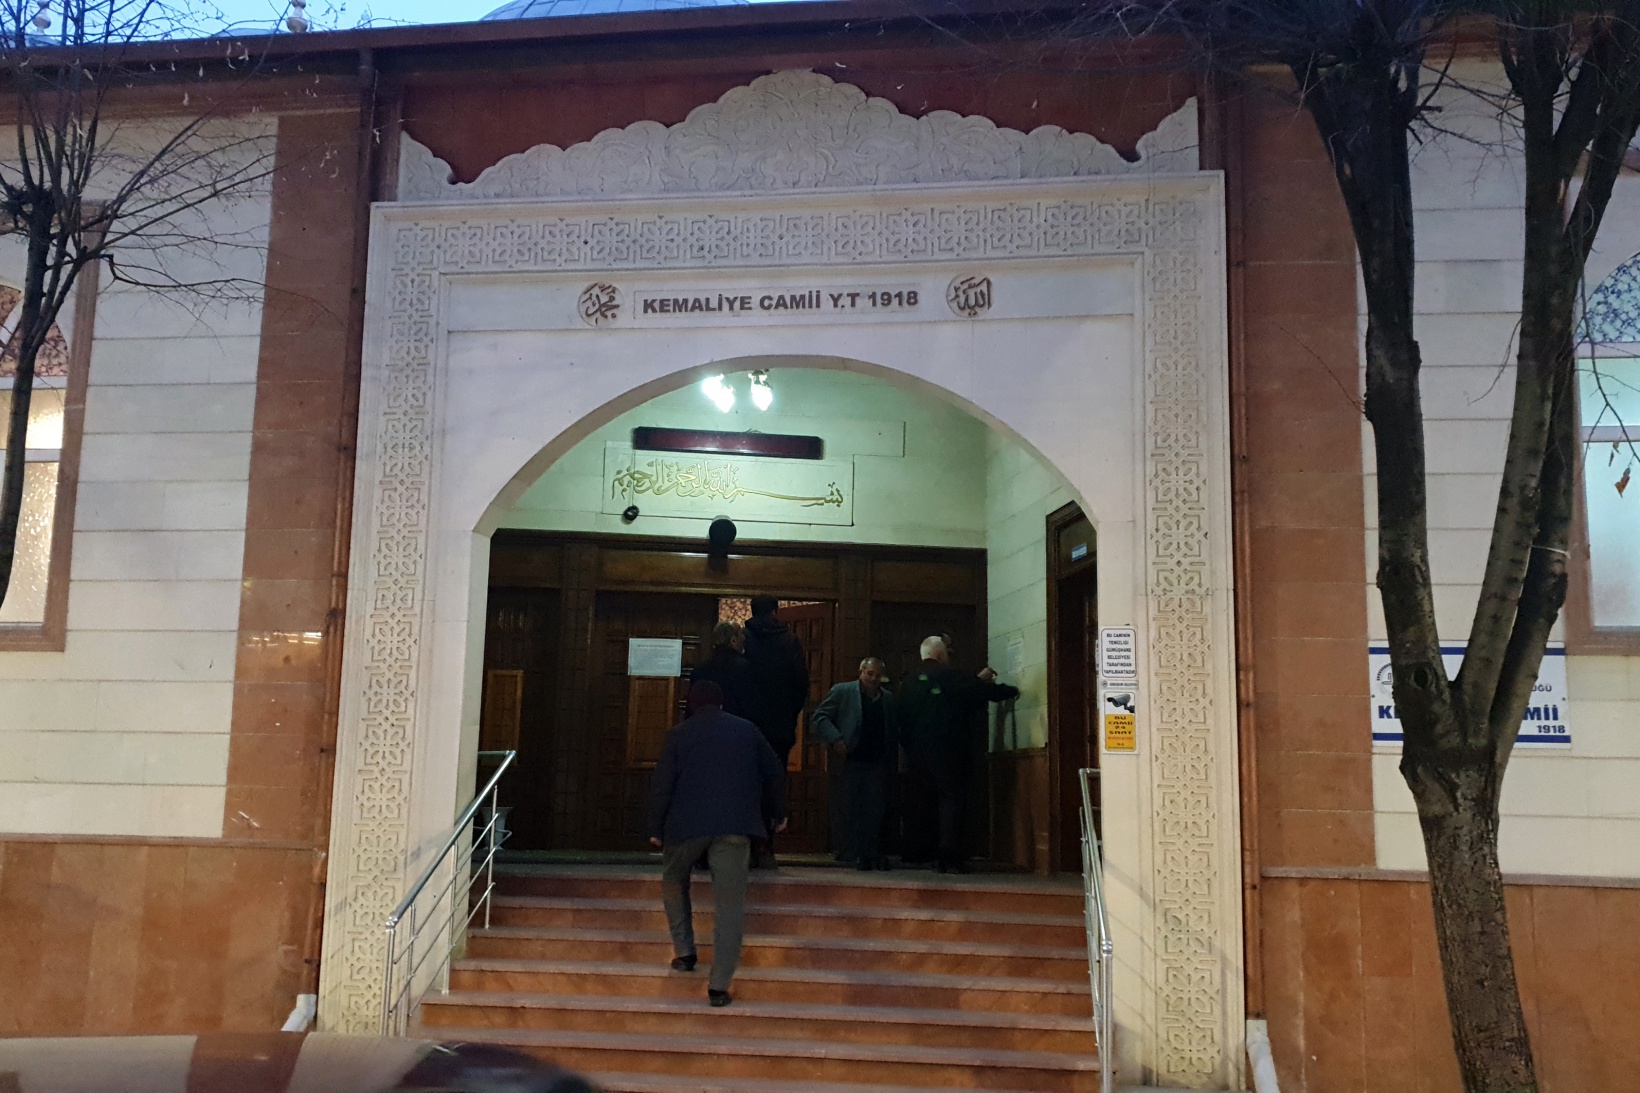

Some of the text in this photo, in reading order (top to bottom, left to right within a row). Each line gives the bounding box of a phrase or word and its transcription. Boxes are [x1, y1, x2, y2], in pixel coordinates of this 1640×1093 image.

[643, 290, 919, 314] KEMALİYE CAMİİ Y.T 1918
[1522, 704, 1559, 721] Mİİ
[1536, 724, 1566, 734] 1918
